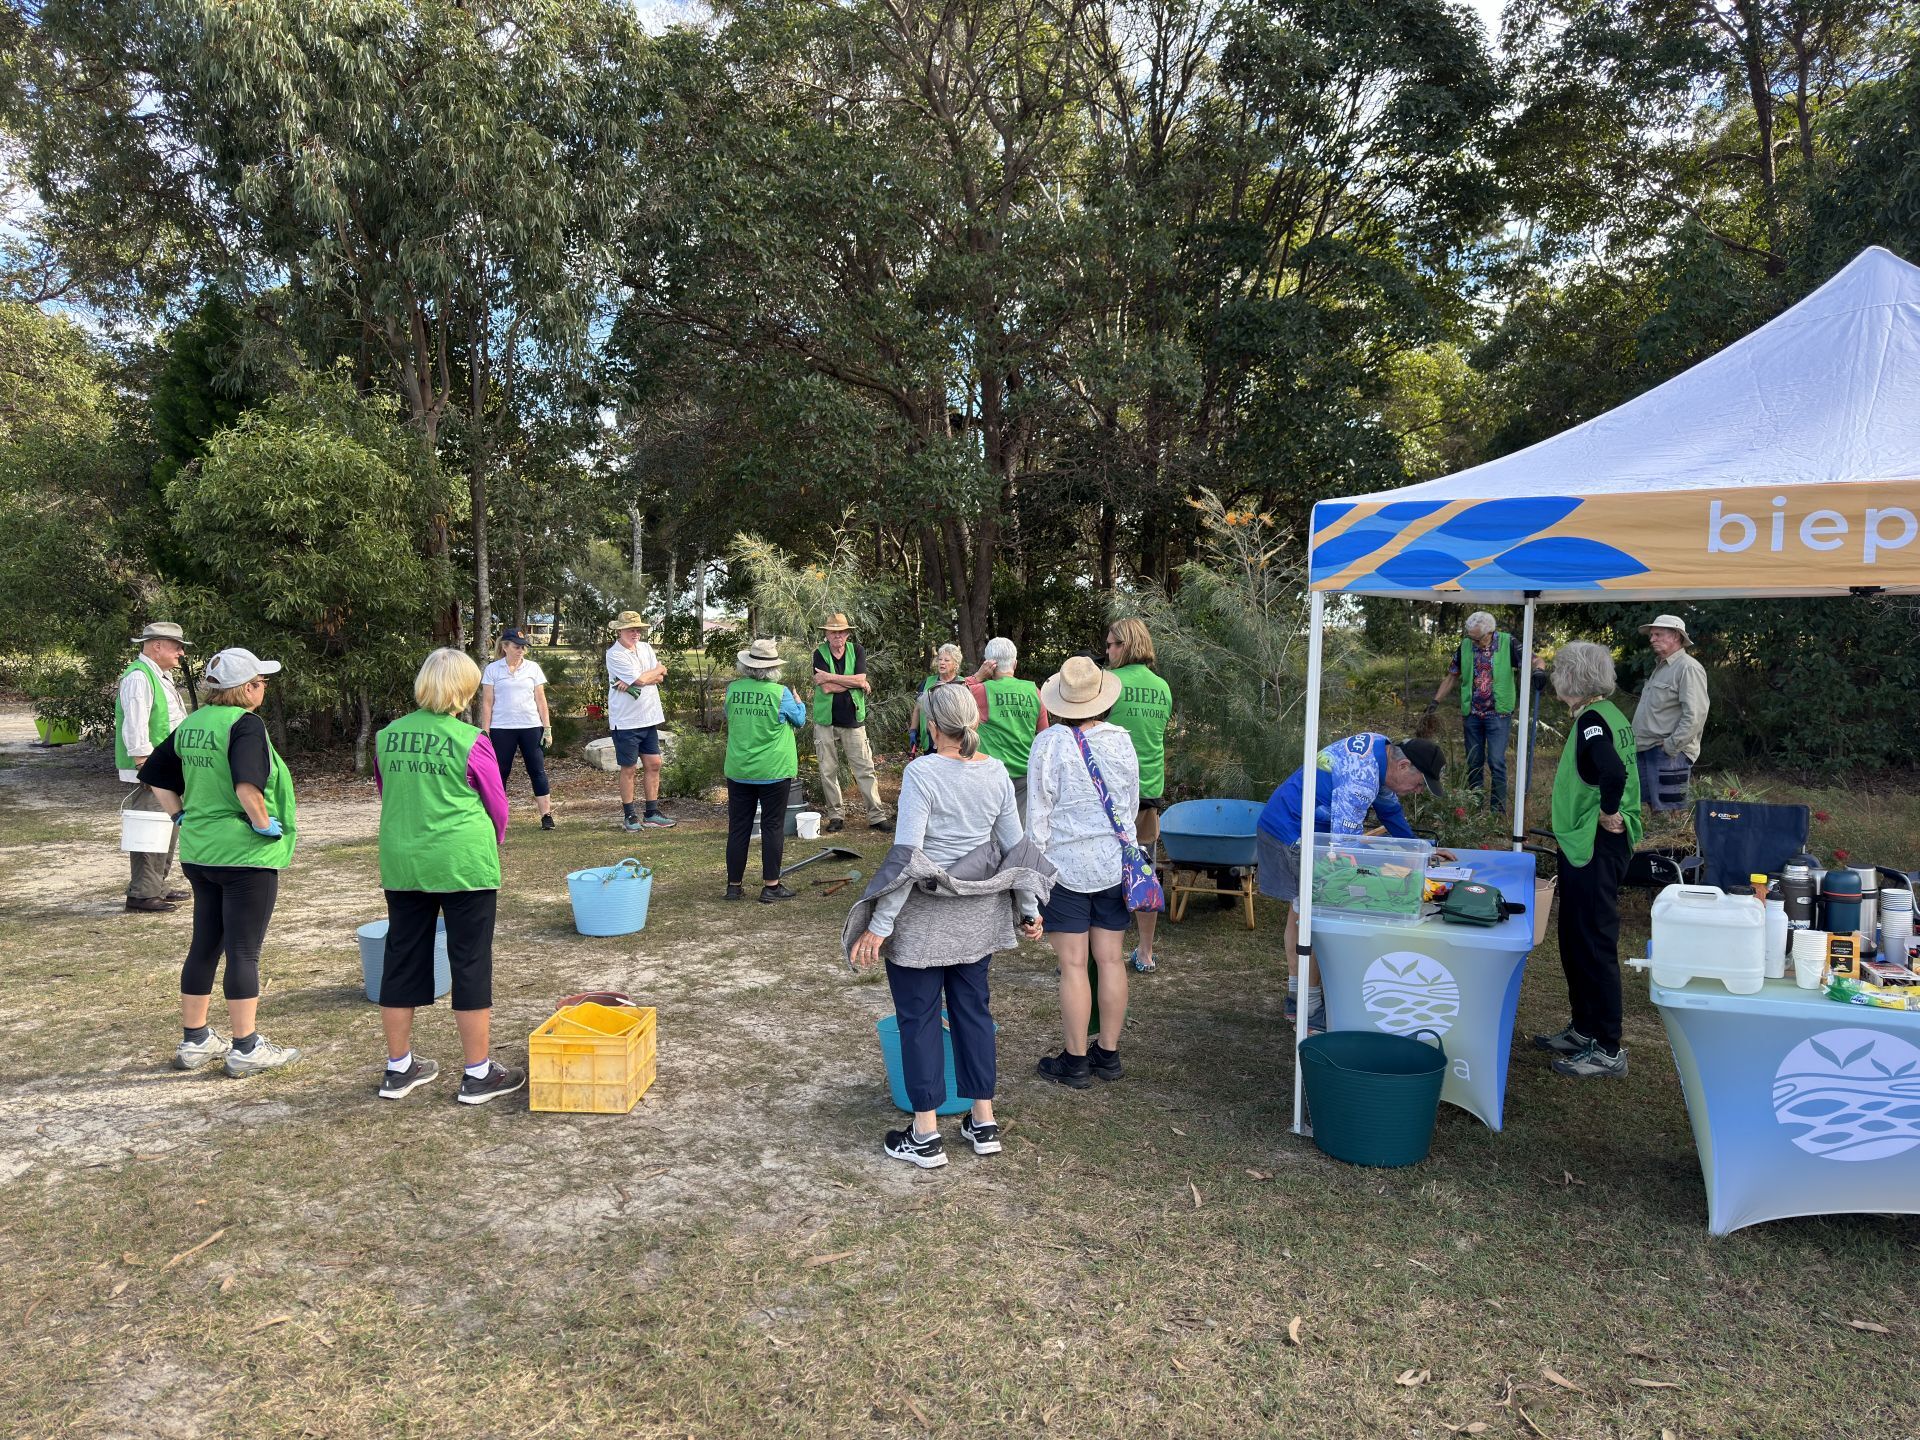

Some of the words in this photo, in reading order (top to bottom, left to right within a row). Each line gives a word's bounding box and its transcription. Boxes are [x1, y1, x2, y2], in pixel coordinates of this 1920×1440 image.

[1707, 495, 1919, 564] biep
[732, 691, 773, 707] BIEPA
[995, 692, 1033, 708] BIEPA
[1123, 686, 1167, 706] BIEPA
[733, 707, 744, 715] AT
[745, 708, 769, 717] WORK
[999, 710, 1009, 718] AT
[1010, 709, 1031, 719] WORK
[1126, 707, 1139, 717] AT
[1140, 708, 1165, 719] WORK
[384, 731, 456, 759] BIEPA
[1352, 734, 1367, 753] BCF
[187, 755, 215, 769] WORK
[389, 759, 404, 772] AT
[407, 760, 449, 776] WORK
